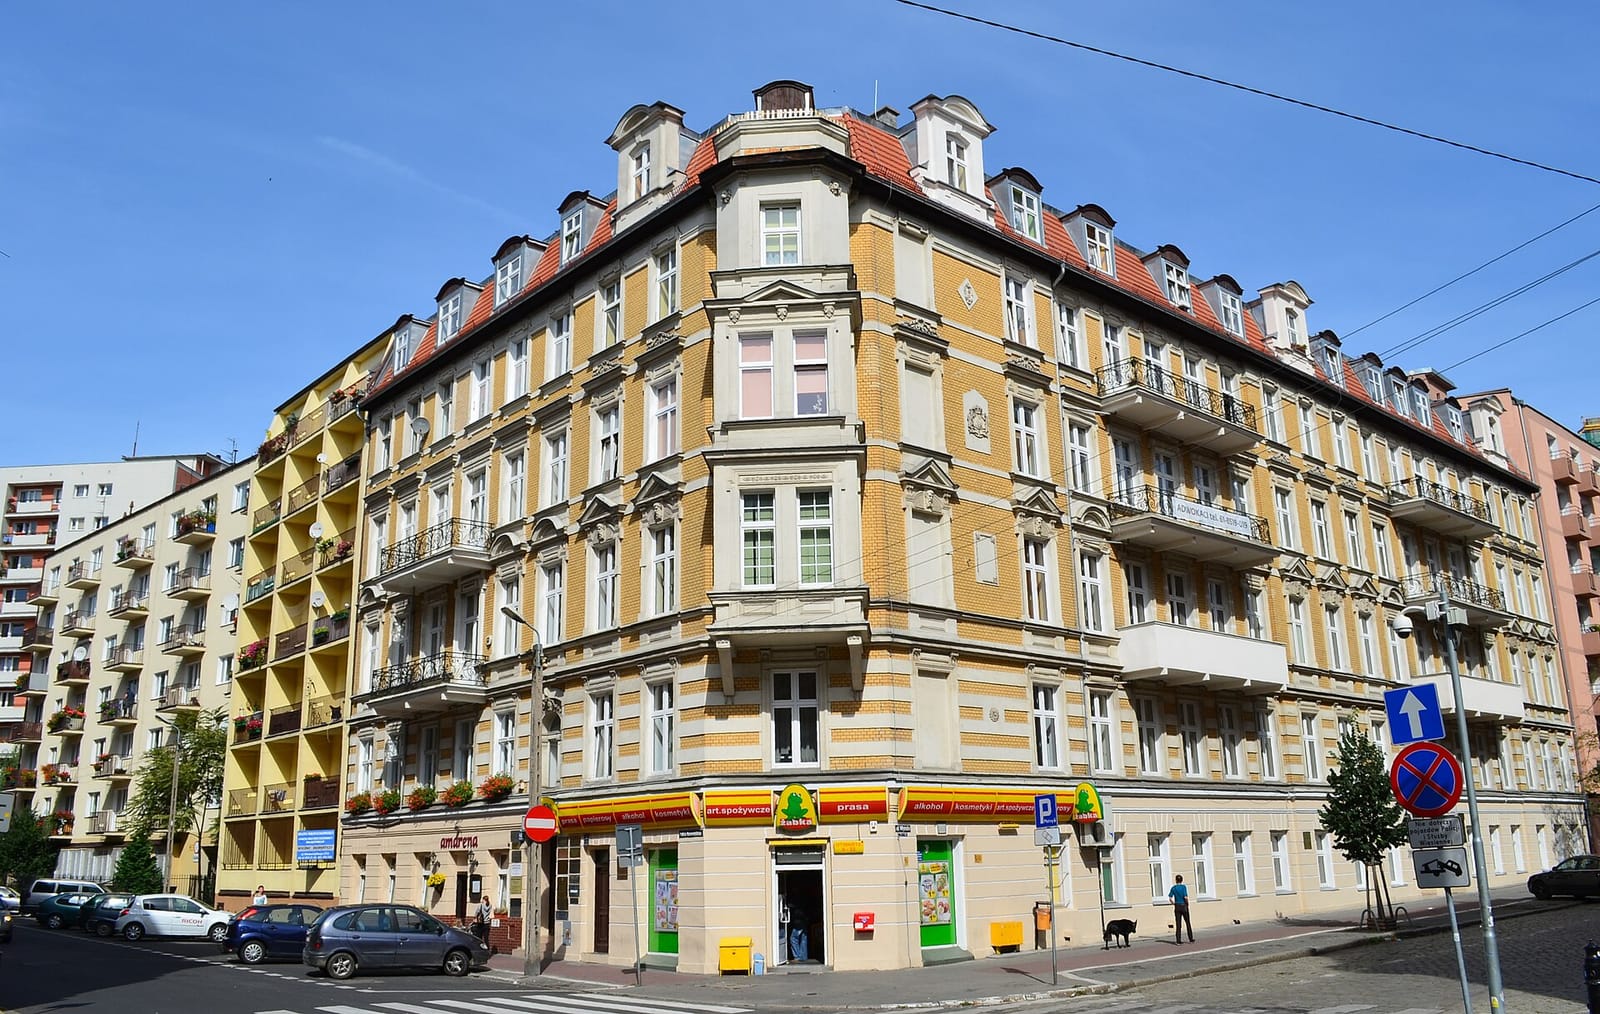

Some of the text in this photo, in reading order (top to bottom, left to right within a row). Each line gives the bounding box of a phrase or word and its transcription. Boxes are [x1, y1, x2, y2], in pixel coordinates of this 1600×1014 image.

[1177, 503, 1208, 519] ADWOKACI
[706, 805, 771, 816] art.spożywcze
[837, 804, 869, 812] prasa
[955, 803, 993, 812] kosmetyki
[561, 807, 691, 825] prasa papierosy alkohol kosmetyki
[440, 836, 479, 849] amarena
